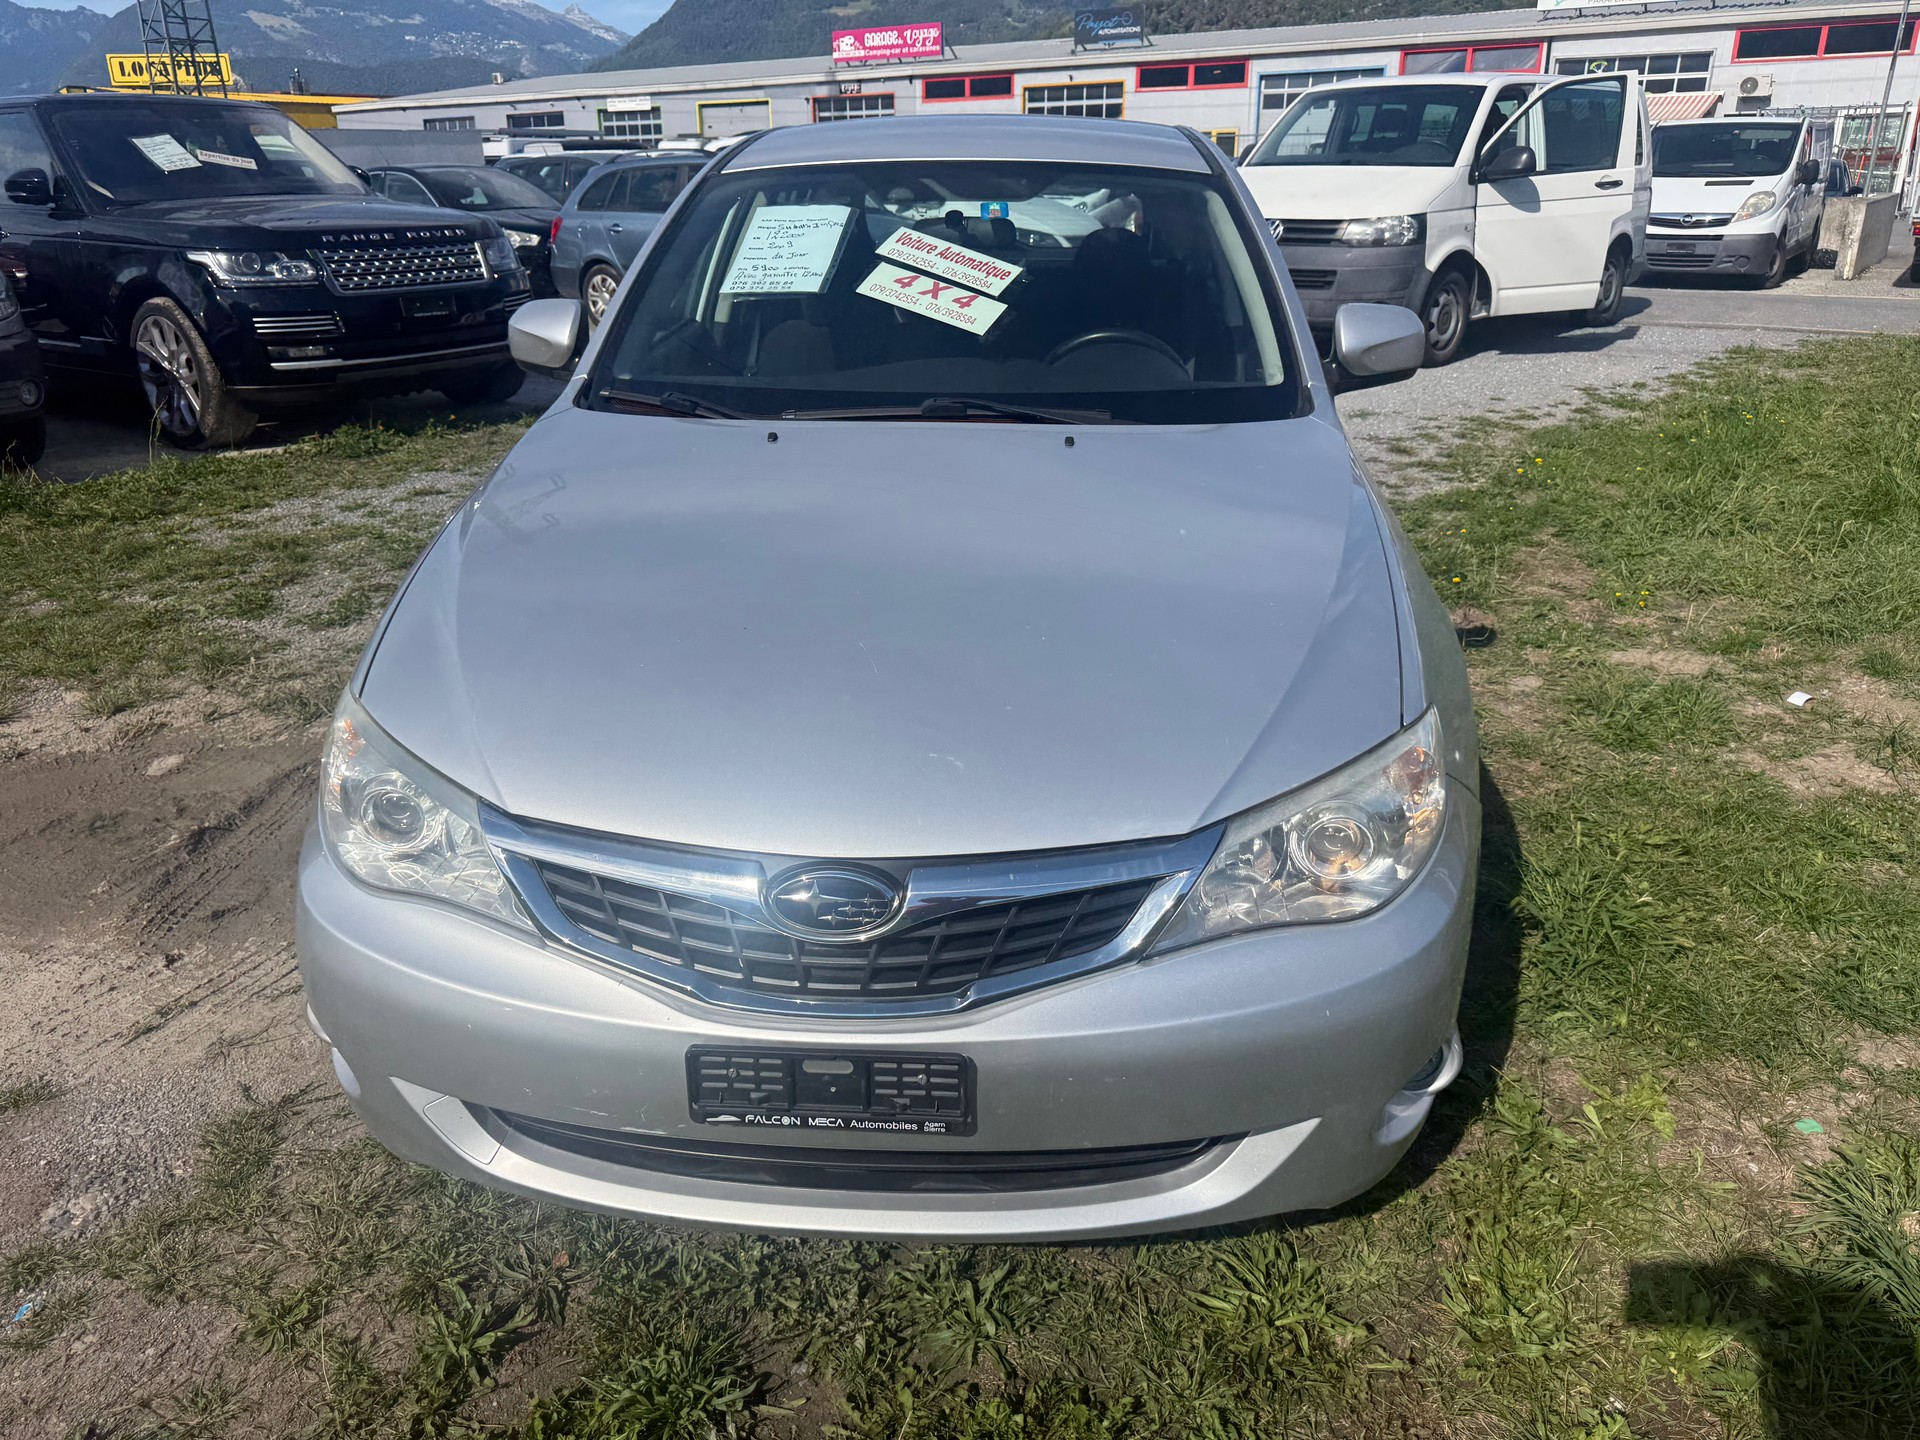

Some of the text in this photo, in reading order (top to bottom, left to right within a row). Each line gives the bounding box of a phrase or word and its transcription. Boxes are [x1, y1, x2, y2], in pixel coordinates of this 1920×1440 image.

[864, 31, 898, 47] GARAGE
[904, 27, 940, 46] Voyage
[865, 47, 901, 56] Camping-car
[909, 45, 940, 53] caravanes
[200, 151, 231, 162] Expertise
[322, 229, 467, 242] RANGE ROVER
[895, 231, 1012, 281] Voiture Automatique
[887, 248, 937, 270] 079/3742554
[941, 267, 993, 290] 076/3928584
[893, 274, 980, 310] 4 X 4
[869, 283, 920, 306] 079/3742554
[925, 302, 978, 326] 076/3928584
[745, 1114, 918, 1131] FALCON MECA Automobiles
